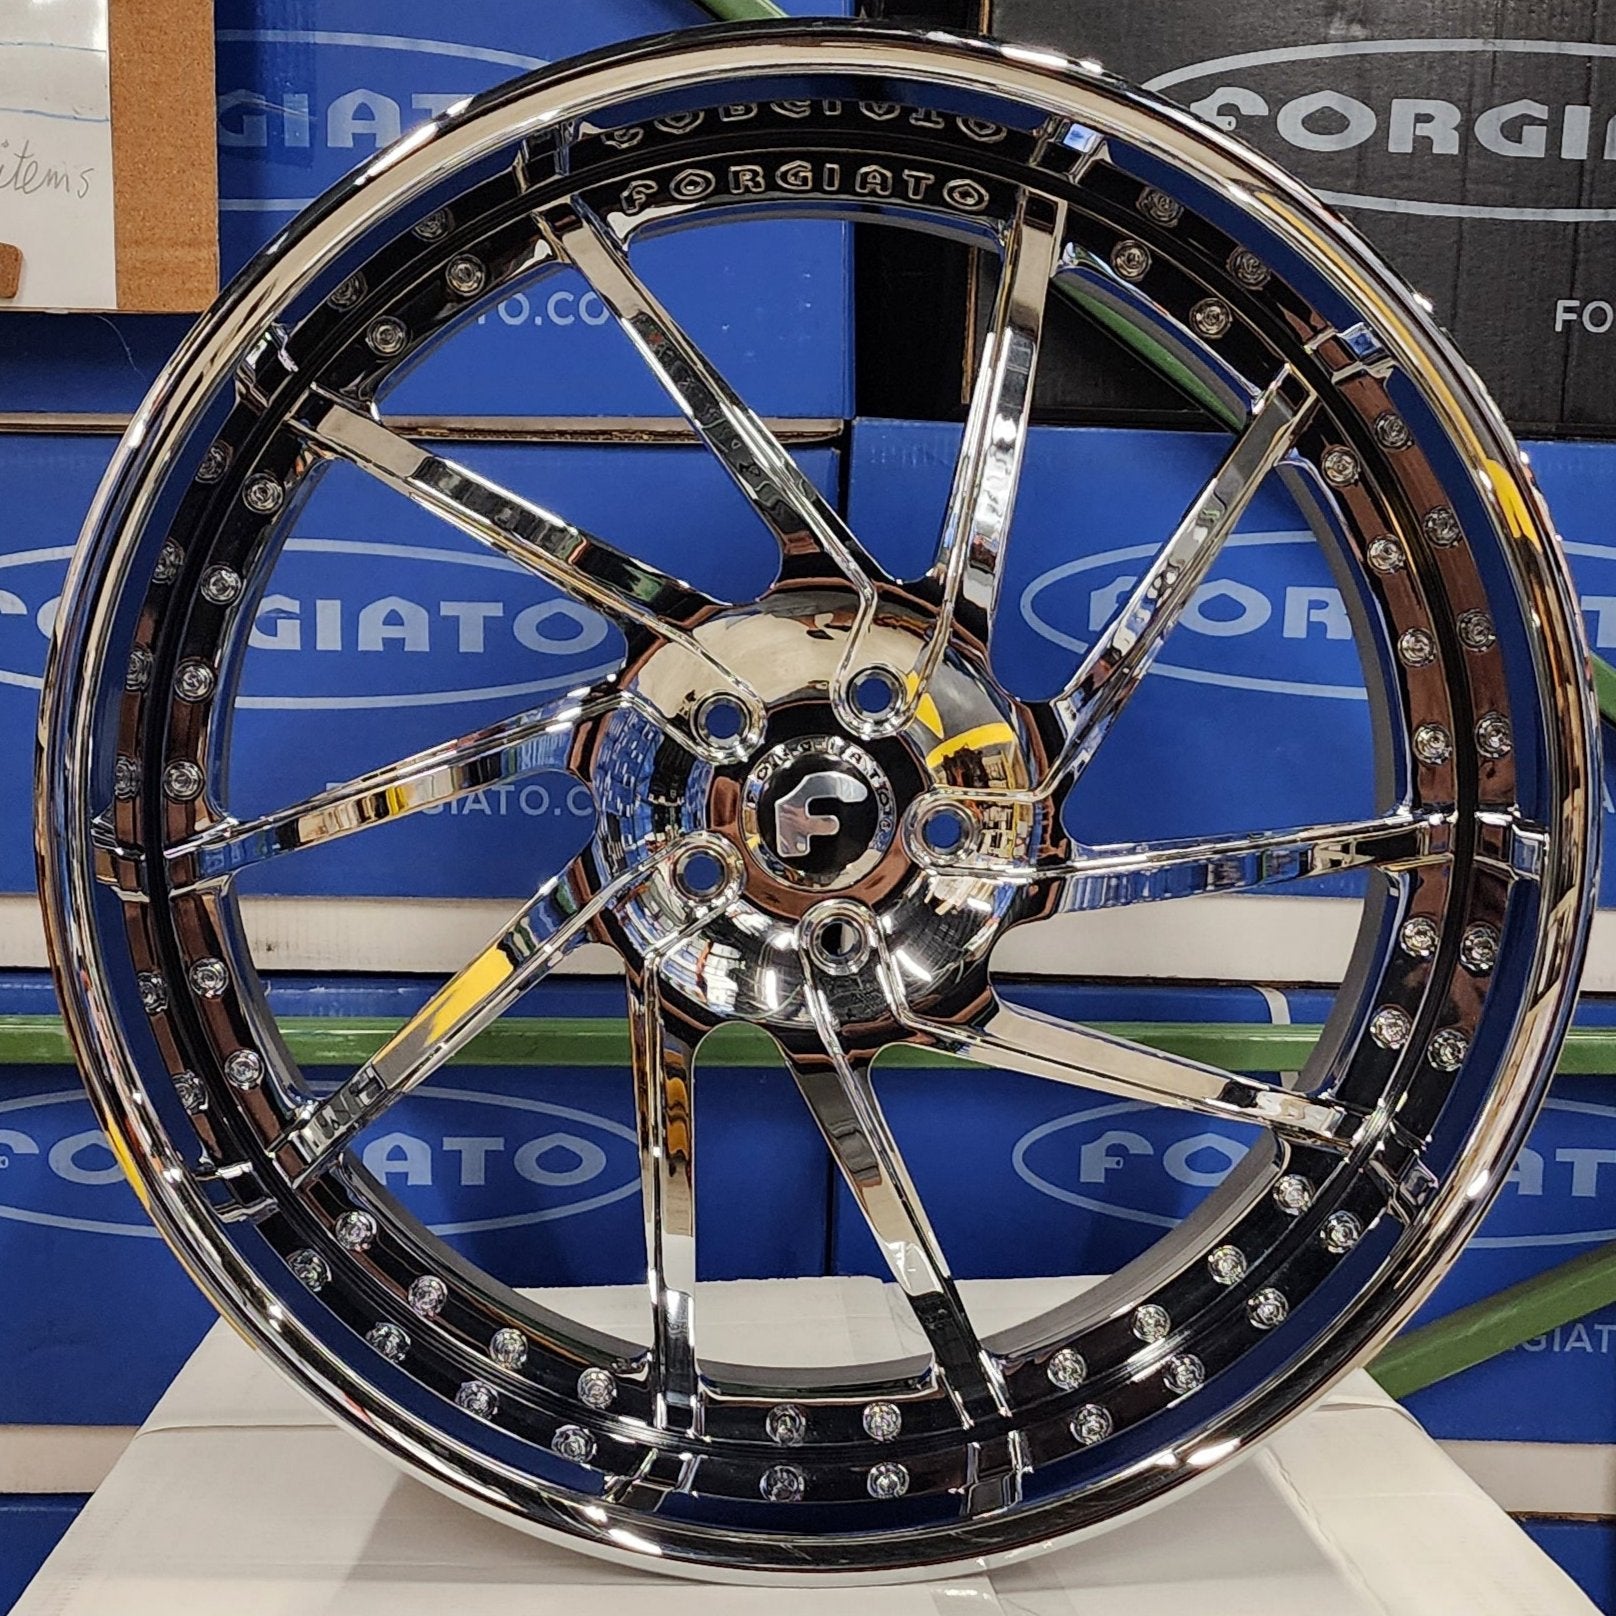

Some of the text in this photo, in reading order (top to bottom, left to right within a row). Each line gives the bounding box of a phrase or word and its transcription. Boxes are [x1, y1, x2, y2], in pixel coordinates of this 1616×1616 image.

[1190, 86, 1616, 160] FORGI
[620, 160, 990, 215] FORGIATO
[478, 291, 610, 326] O.CO
[1554, 299, 1614, 333] FO
